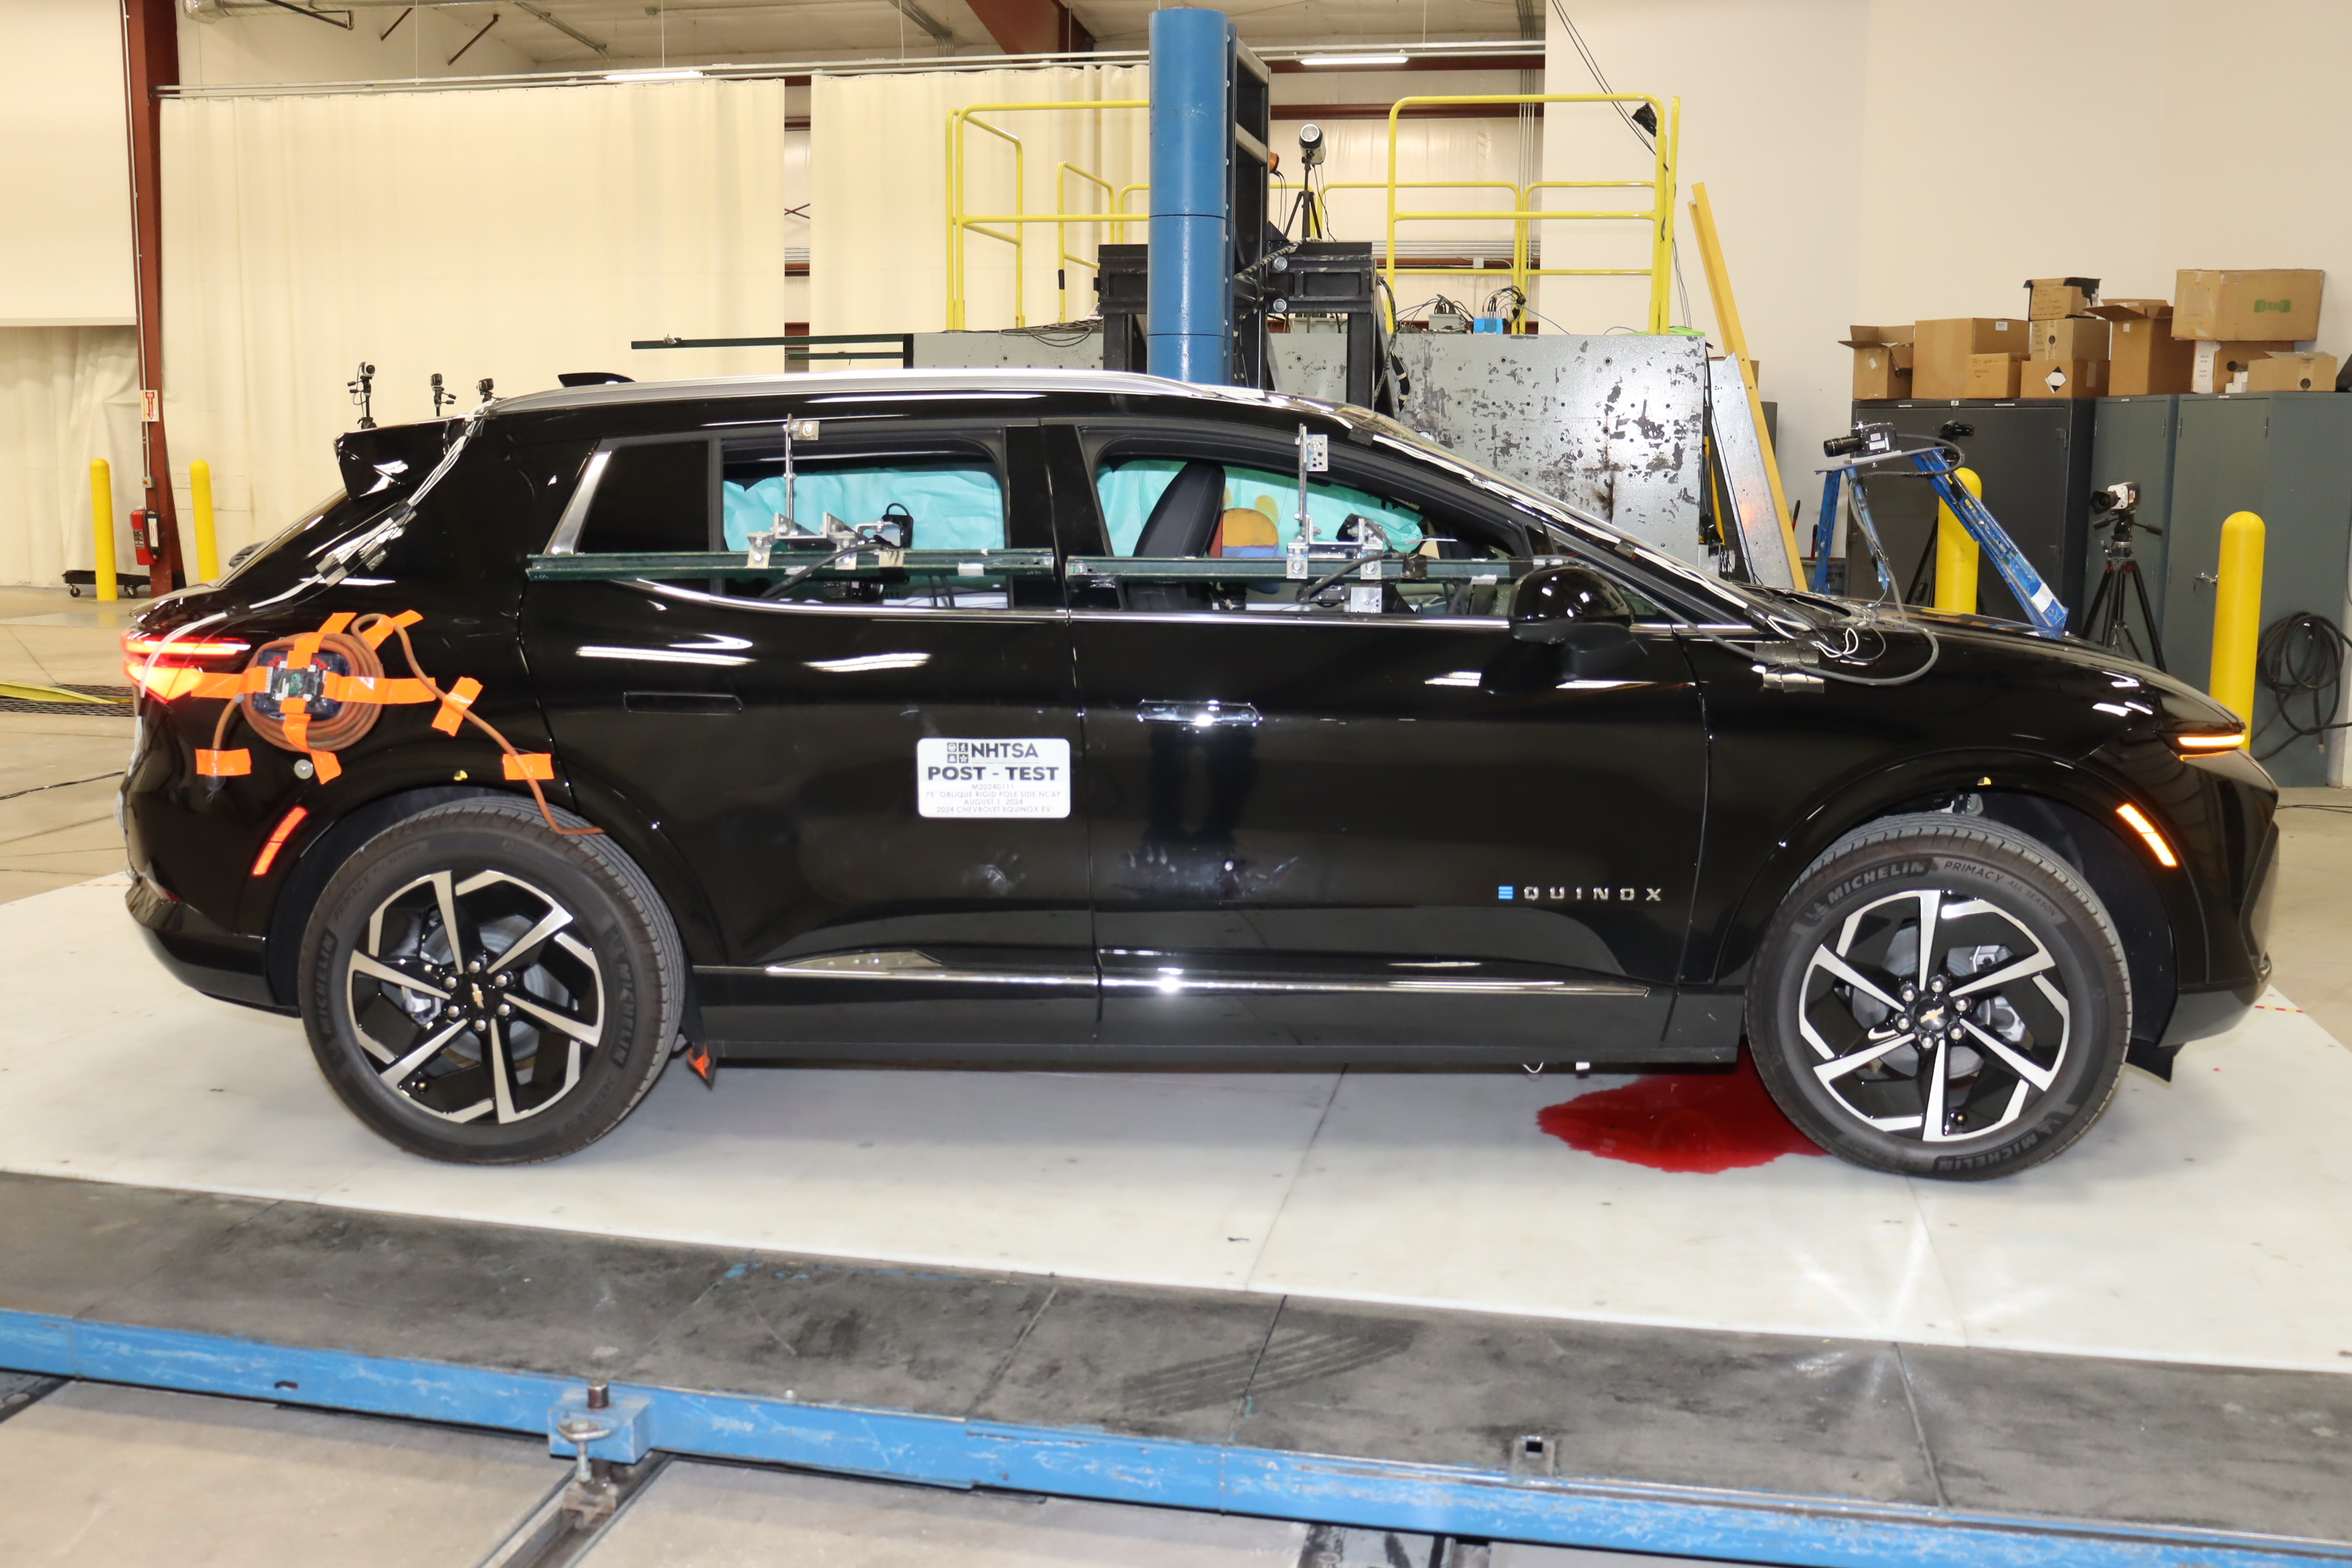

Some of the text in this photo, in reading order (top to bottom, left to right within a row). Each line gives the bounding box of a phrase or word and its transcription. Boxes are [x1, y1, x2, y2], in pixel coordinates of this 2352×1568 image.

[971, 742, 1039, 759] NHTSA
[928, 766, 987, 781] POST
[1004, 766, 1060, 781] TEST
[1498, 885, 1662, 901] EQUINOX
[1827, 861, 2058, 917] MICHELIN PRIMACY ALL SEASON
[614, 963, 634, 1064] MICHELIN
[1938, 1133, 2038, 1170] MICHELIN
